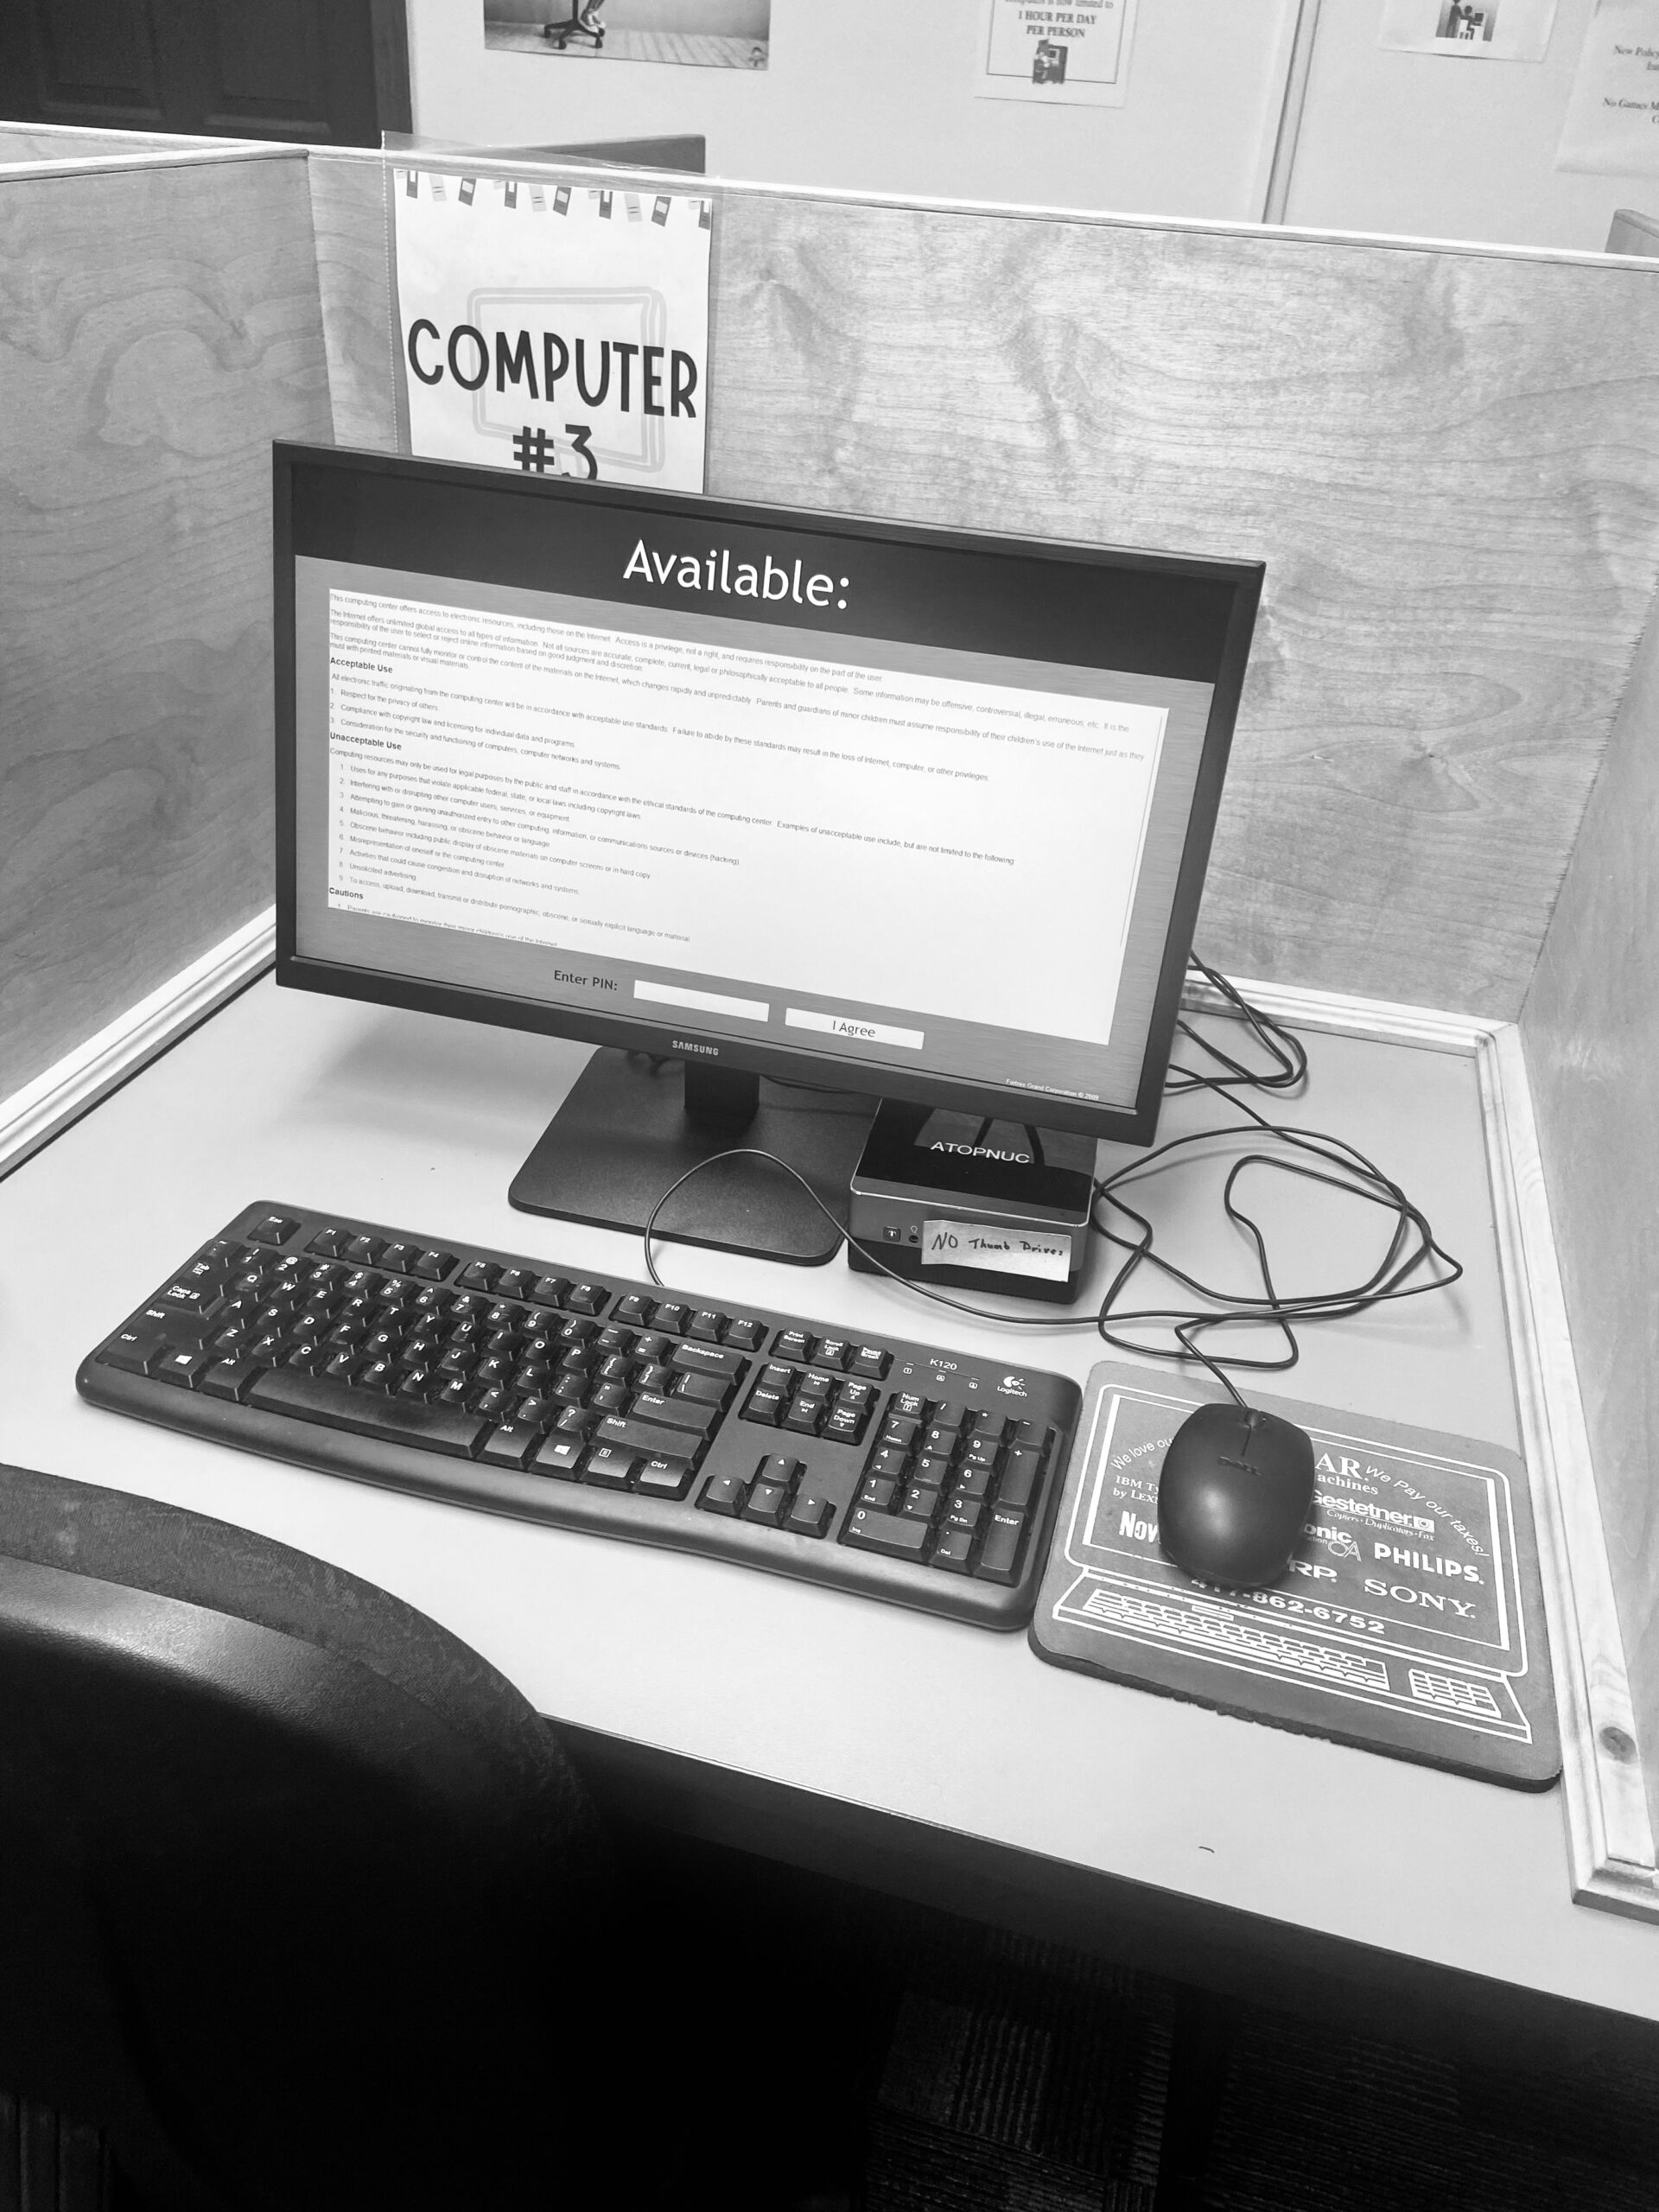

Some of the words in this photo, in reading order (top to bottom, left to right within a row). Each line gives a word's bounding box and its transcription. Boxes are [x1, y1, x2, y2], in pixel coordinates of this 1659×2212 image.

[1018, 10, 1022, 19] 1
[1025, 10, 1053, 22] HOUR
[1055, 12, 1074, 22] PER
[1077, 14, 1097, 24] DAY
[1027, 25, 1045, 35] PER
[1047, 26, 1085, 38] PERSON
[1603, 98, 1617, 107] No
[1618, 99, 1647, 110] Games
[408, 319, 697, 418] COMPUTER
[512, 423, 598, 480] #3
[623, 539, 849, 609] Available:
[330, 657, 375, 671] Acceptable
[377, 664, 392, 673] Use
[340, 689, 366, 699] Respect
[387, 697, 410, 707] privacy
[330, 732, 384, 747] Unacceptable
[385, 741, 401, 750] Use
[328, 887, 363, 899] Cautions
[554, 969, 588, 985] Enter
[593, 976, 618, 991] PIN:
[832, 1020, 836, 1031] I
[839, 1022, 876, 1038] Agree
[672, 1039, 719, 1056] SAMSUNG
[931, 1141, 1030, 1163] ATOPNUC
[931, 1232, 958, 1250] NO
[969, 1238, 1010, 1250] Thumb
[195, 1262, 210, 1272] Tab
[172, 1286, 192, 1296] Caps
[146, 1310, 165, 1319] Shift
[682, 1344, 723, 1358] Backspace
[769, 1364, 791, 1373] Insert
[930, 1358, 957, 1370] K120
[808, 1373, 830, 1382] Home
[755, 1390, 779, 1400] Delete
[902, 1393, 919, 1402] Num
[997, 1386, 1027, 1397] Logitech
[642, 1395, 664, 1404] Enter
[799, 1401, 815, 1410] End
[900, 1398, 919, 1408] Lock
[607, 1418, 626, 1427] Shift
[834, 1415, 855, 1424] Down
[1110, 1454, 1132, 1470] We
[1128, 1442, 1155, 1459] love
[1157, 1437, 1175, 1448] ou
[922, 1459, 930, 1467] 5
[1314, 1452, 1370, 1482] AR.
[1116, 1475, 1143, 1490] IBM
[1317, 1474, 1379, 1496] achines
[912, 1490, 919, 1498] 2
[1113, 1487, 1128, 1499] by
[1365, 1465, 1391, 1483] We
[1393, 1479, 1427, 1501] Pay
[1426, 1501, 1453, 1519] our
[1449, 1518, 1491, 1557] taxes!
[995, 1515, 1019, 1524] Enter
[1326, 1509, 1360, 1522] Copiers
[1418, 1531, 1436, 1542] Fax
[1374, 1541, 1484, 1585] PHILIPS.
[1289, 1560, 1338, 1583] RP.
[1364, 1579, 1477, 1619] SONY.
